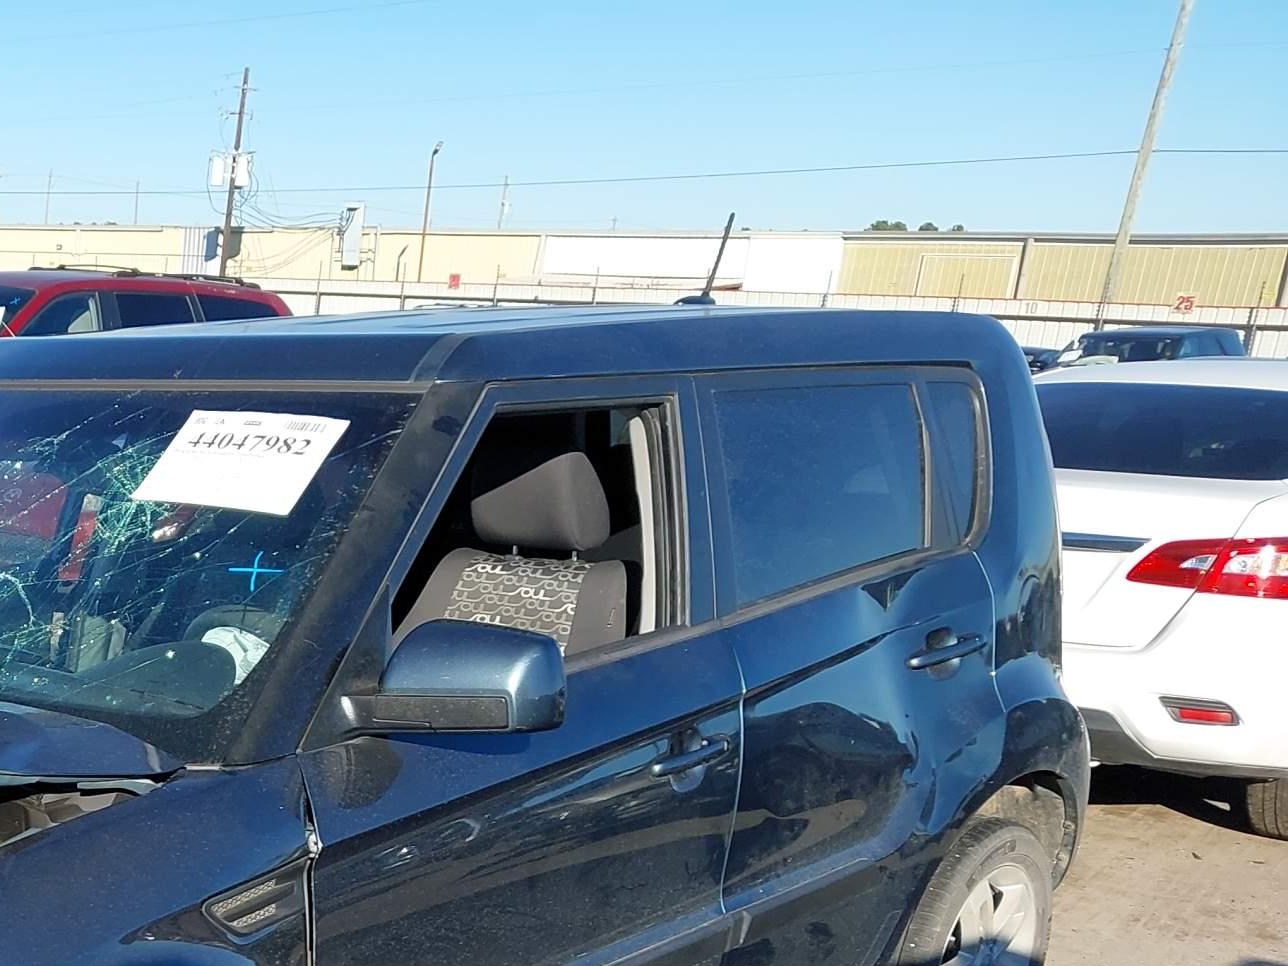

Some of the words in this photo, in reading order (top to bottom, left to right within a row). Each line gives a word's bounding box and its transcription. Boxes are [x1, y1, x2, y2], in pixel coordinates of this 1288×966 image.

[1025, 303, 1039, 314] 10
[1174, 295, 1196, 311] 25
[188, 431, 312, 456] 44047982
